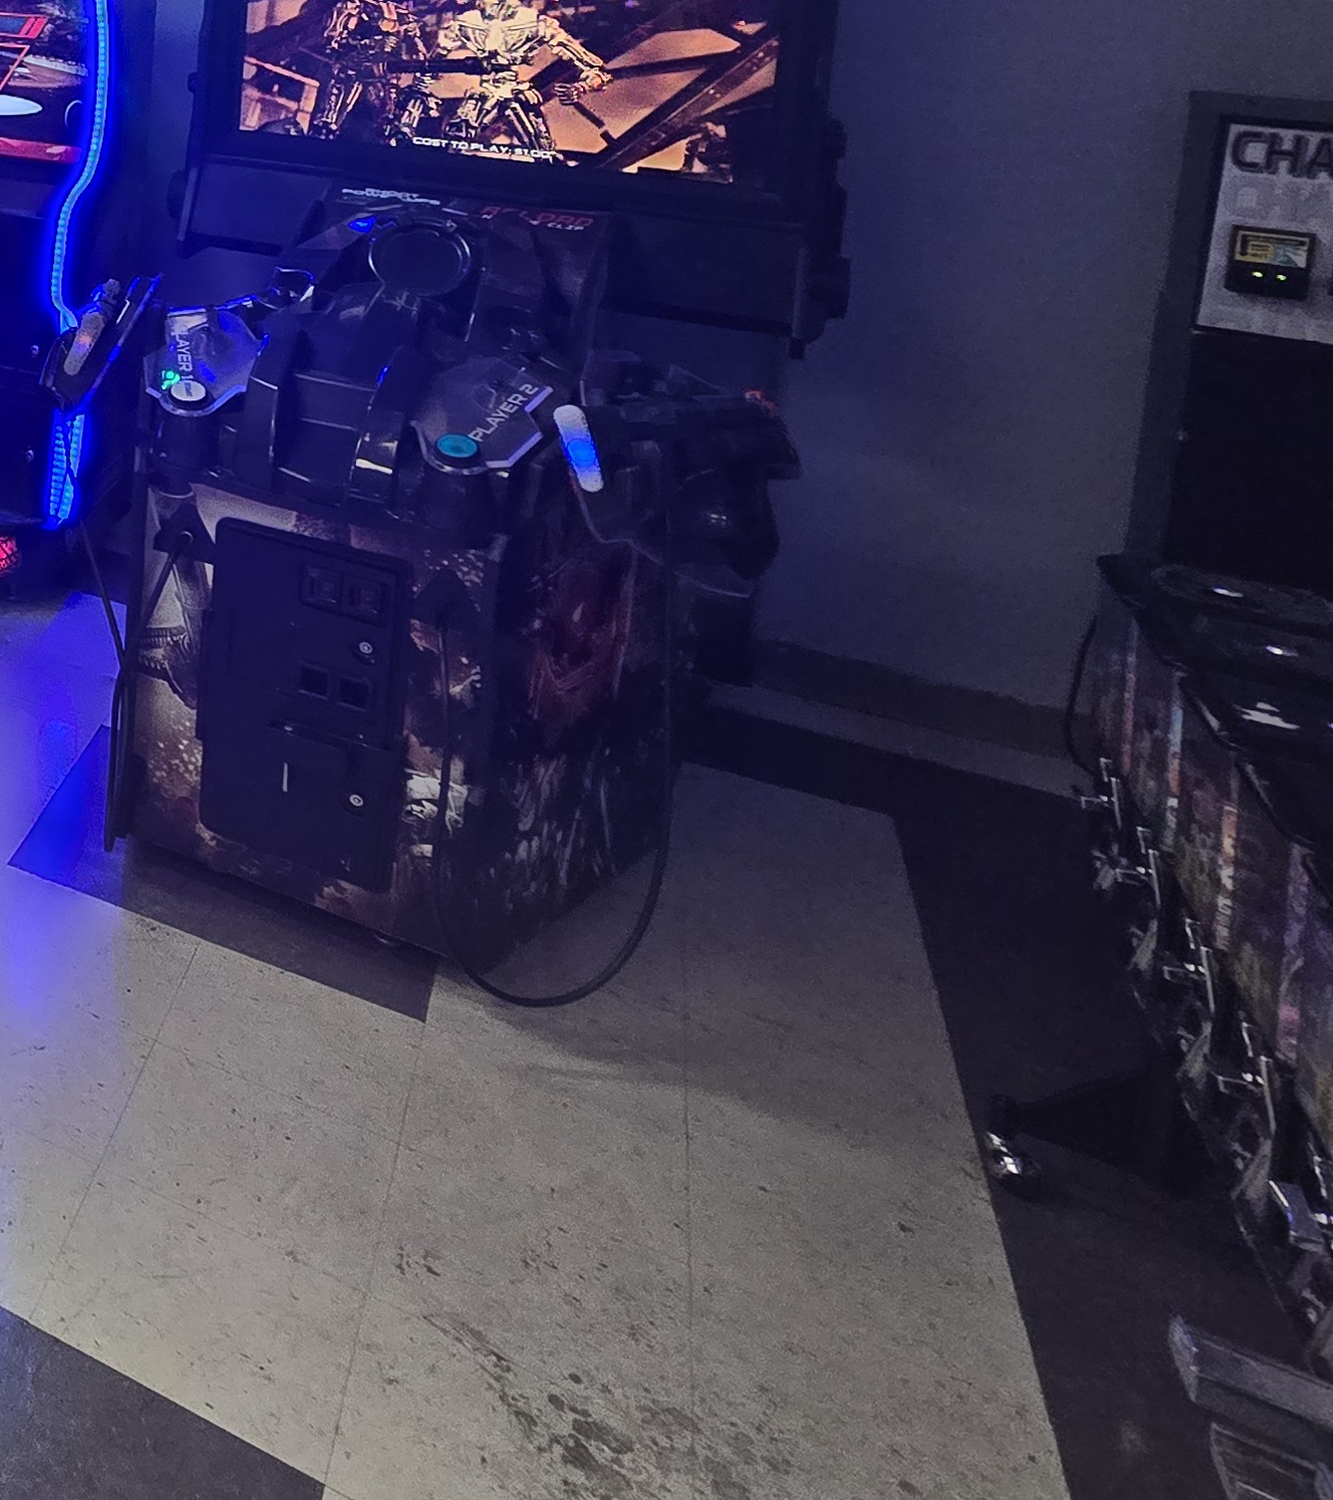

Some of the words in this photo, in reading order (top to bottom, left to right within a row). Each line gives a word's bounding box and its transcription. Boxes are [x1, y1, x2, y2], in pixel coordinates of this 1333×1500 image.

[412, 137, 448, 148] COST
[450, 140, 470, 150] TO
[470, 143, 513, 155] PLAY:
[467, 393, 528, 443] PLAYER
[519, 383, 540, 395] 2
